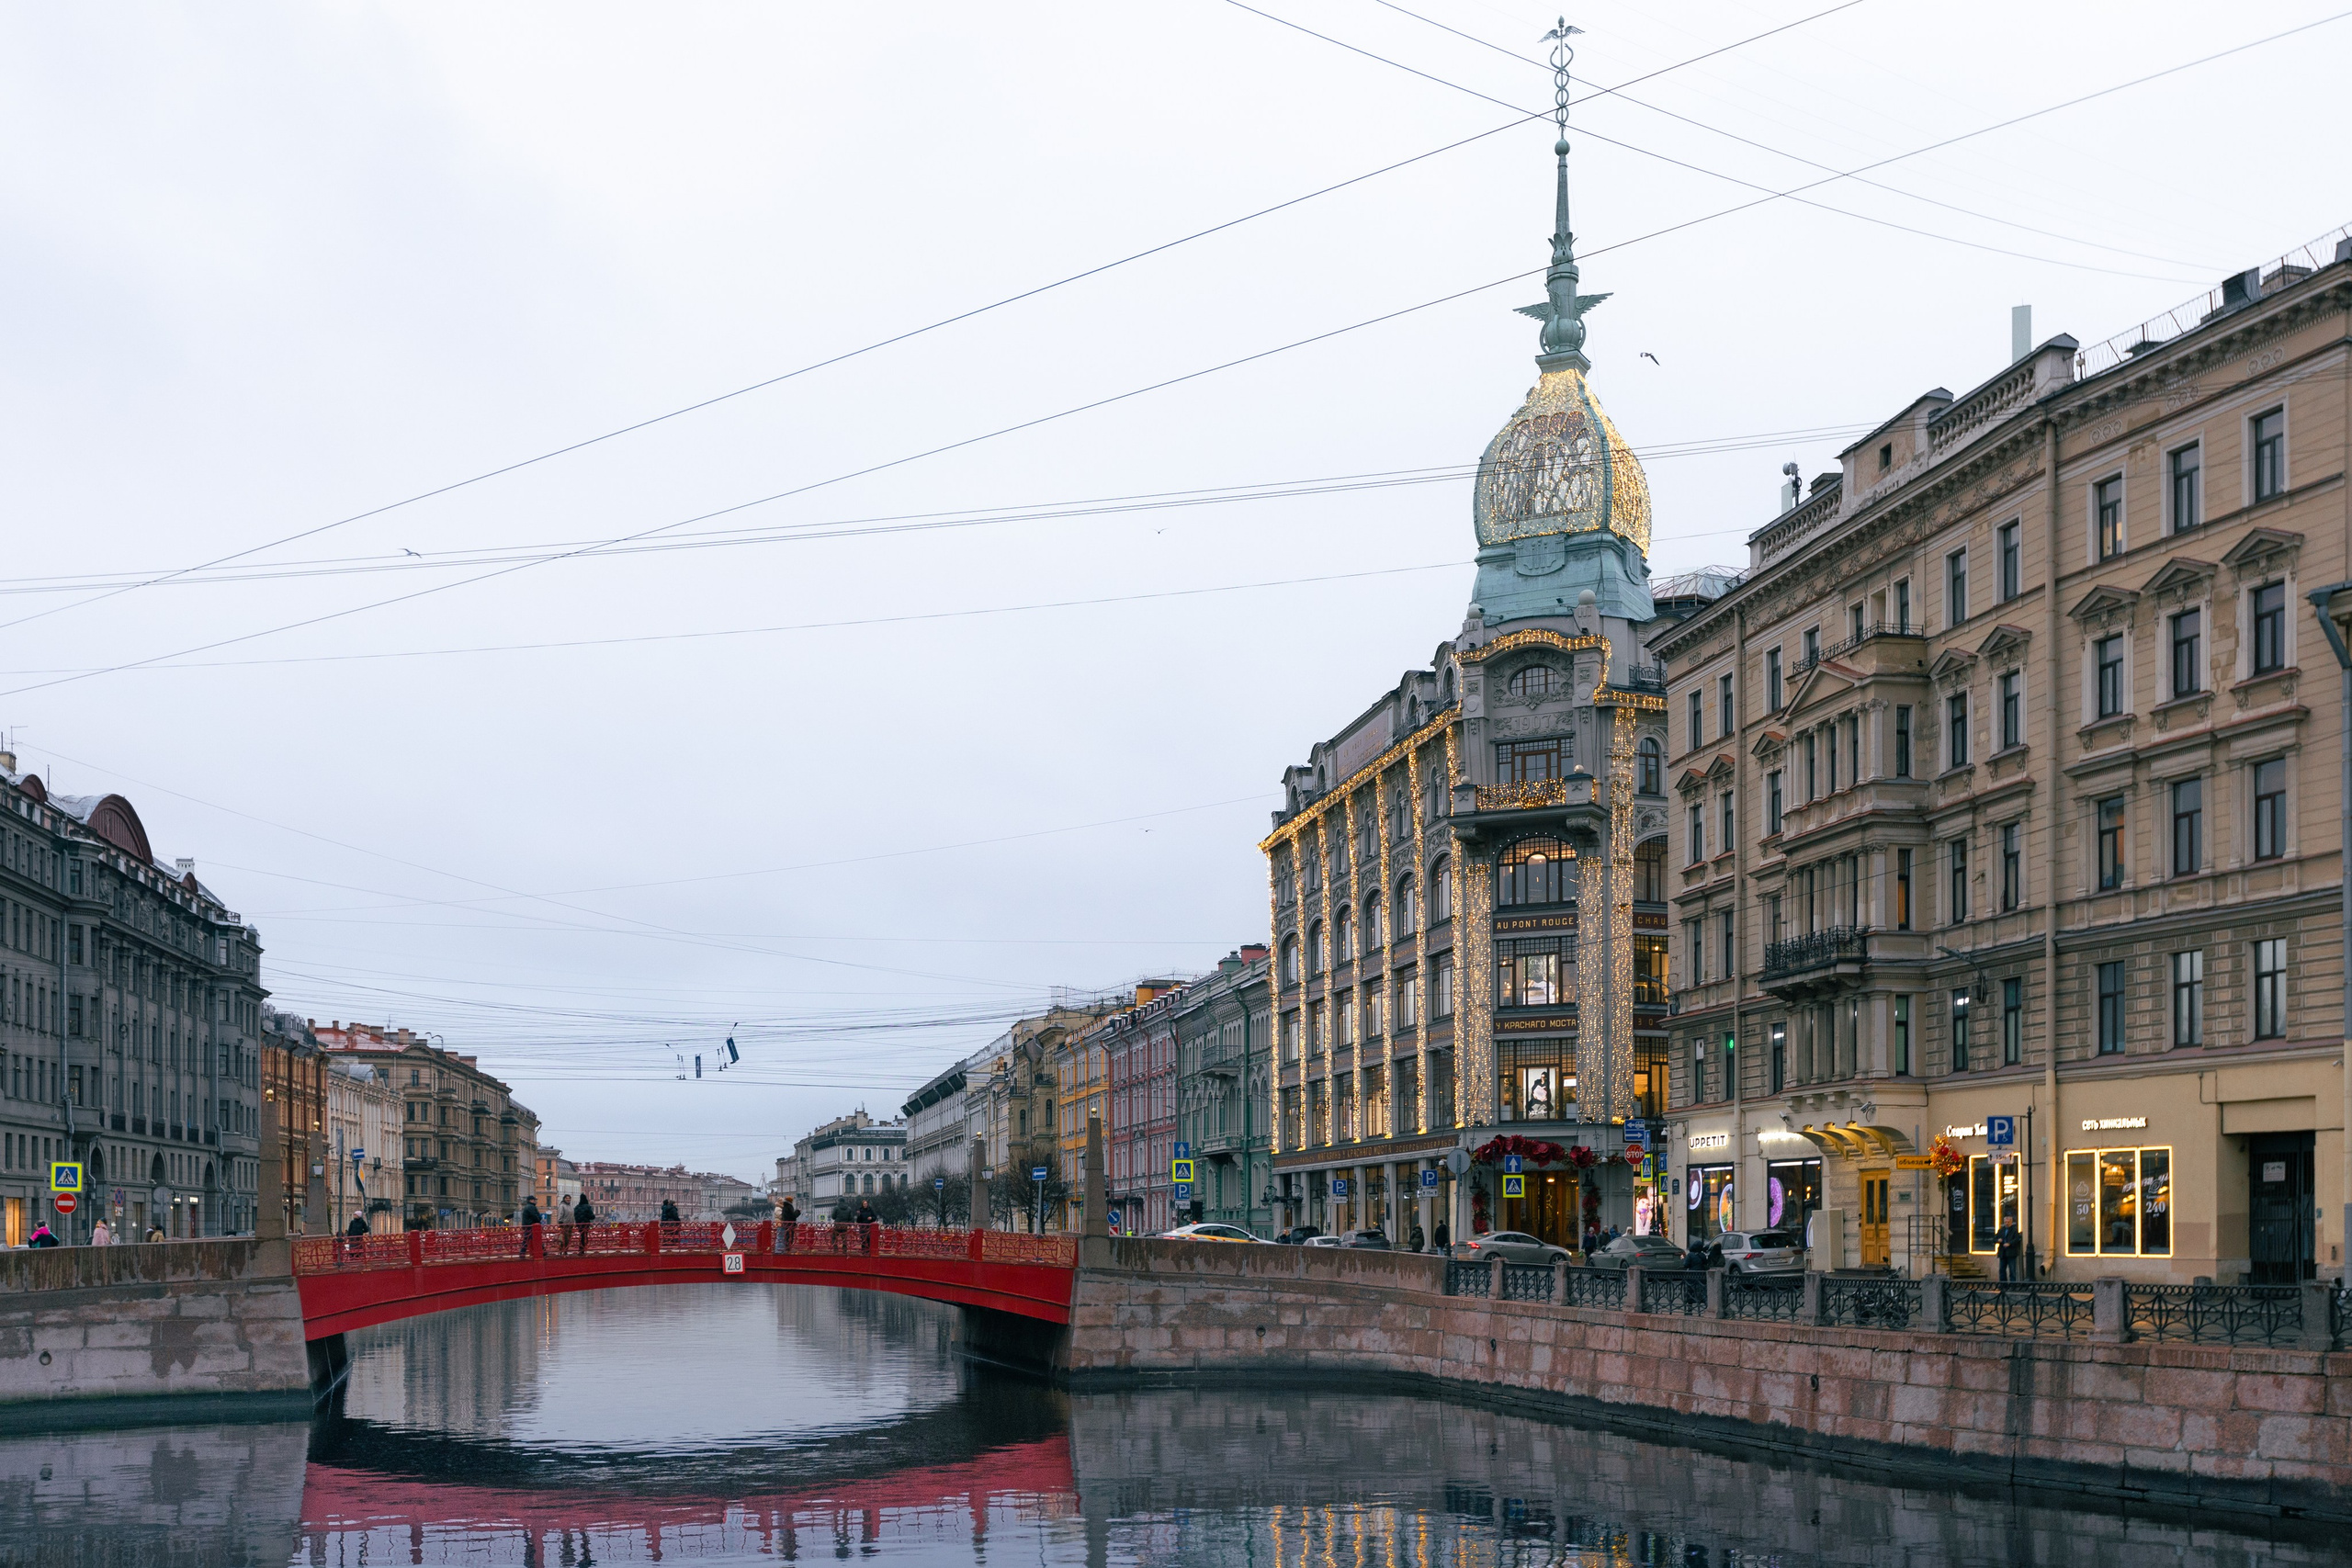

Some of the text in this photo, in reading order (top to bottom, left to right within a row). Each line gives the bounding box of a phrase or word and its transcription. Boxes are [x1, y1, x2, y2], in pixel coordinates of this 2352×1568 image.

[1514, 715, 1551, 731] 1907
[1497, 917, 1574, 930] AU PONT ROUGE
[1496, 1019, 1577, 1030] У КРАСНАГО МОСТА
[2082, 1117, 2146, 1130] сеть хинкальных
[1689, 1135, 1725, 1148] UPPETIT
[2076, 1203, 2089, 1215] 50
[2145, 1201, 2166, 1213] 240
[727, 1256, 741, 1270] 2.8
